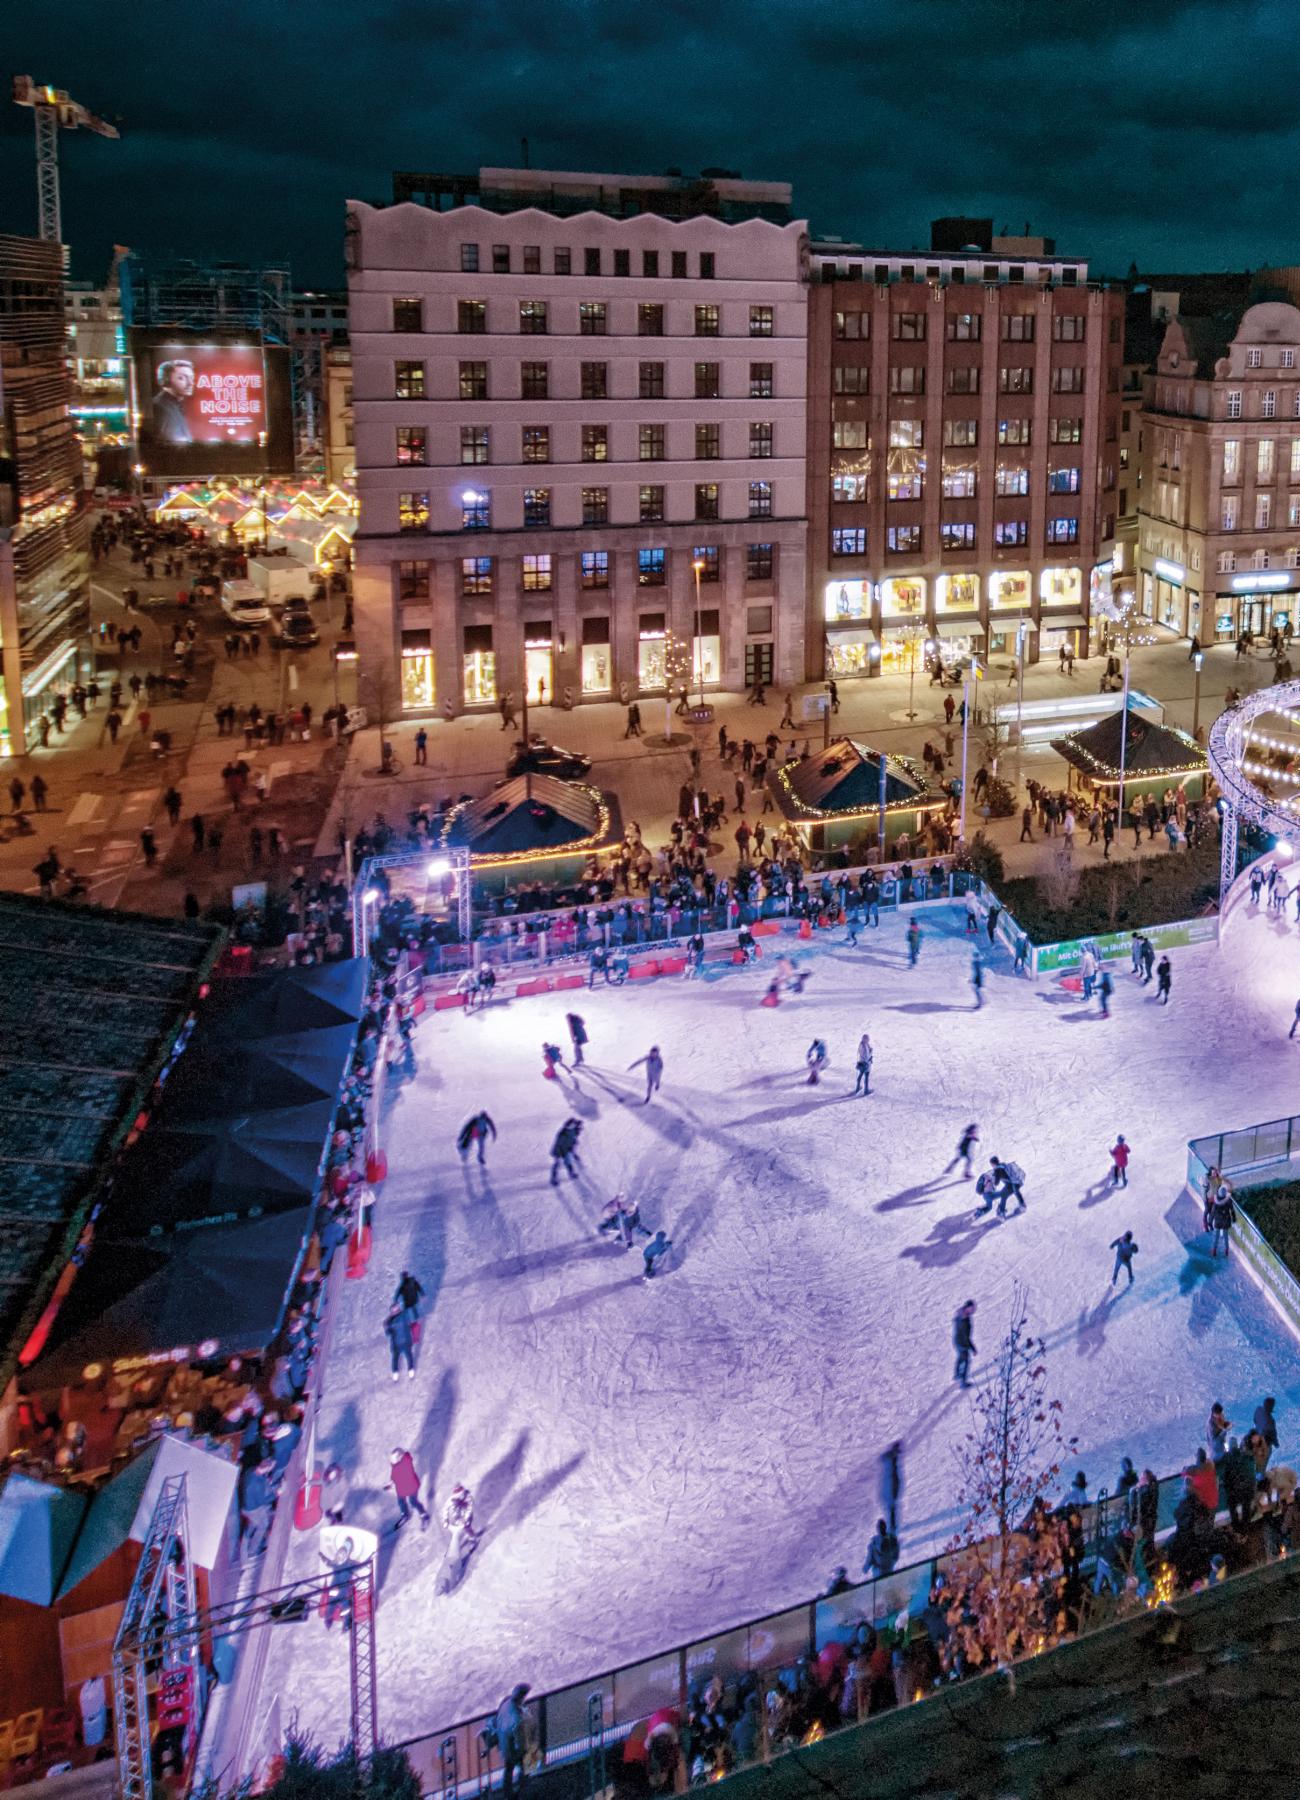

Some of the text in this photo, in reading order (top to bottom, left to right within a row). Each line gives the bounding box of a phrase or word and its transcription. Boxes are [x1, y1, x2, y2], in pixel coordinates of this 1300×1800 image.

[197, 375, 262, 388] ABOVE
[212, 388, 248, 401] THE
[200, 400, 261, 413] NOISE
